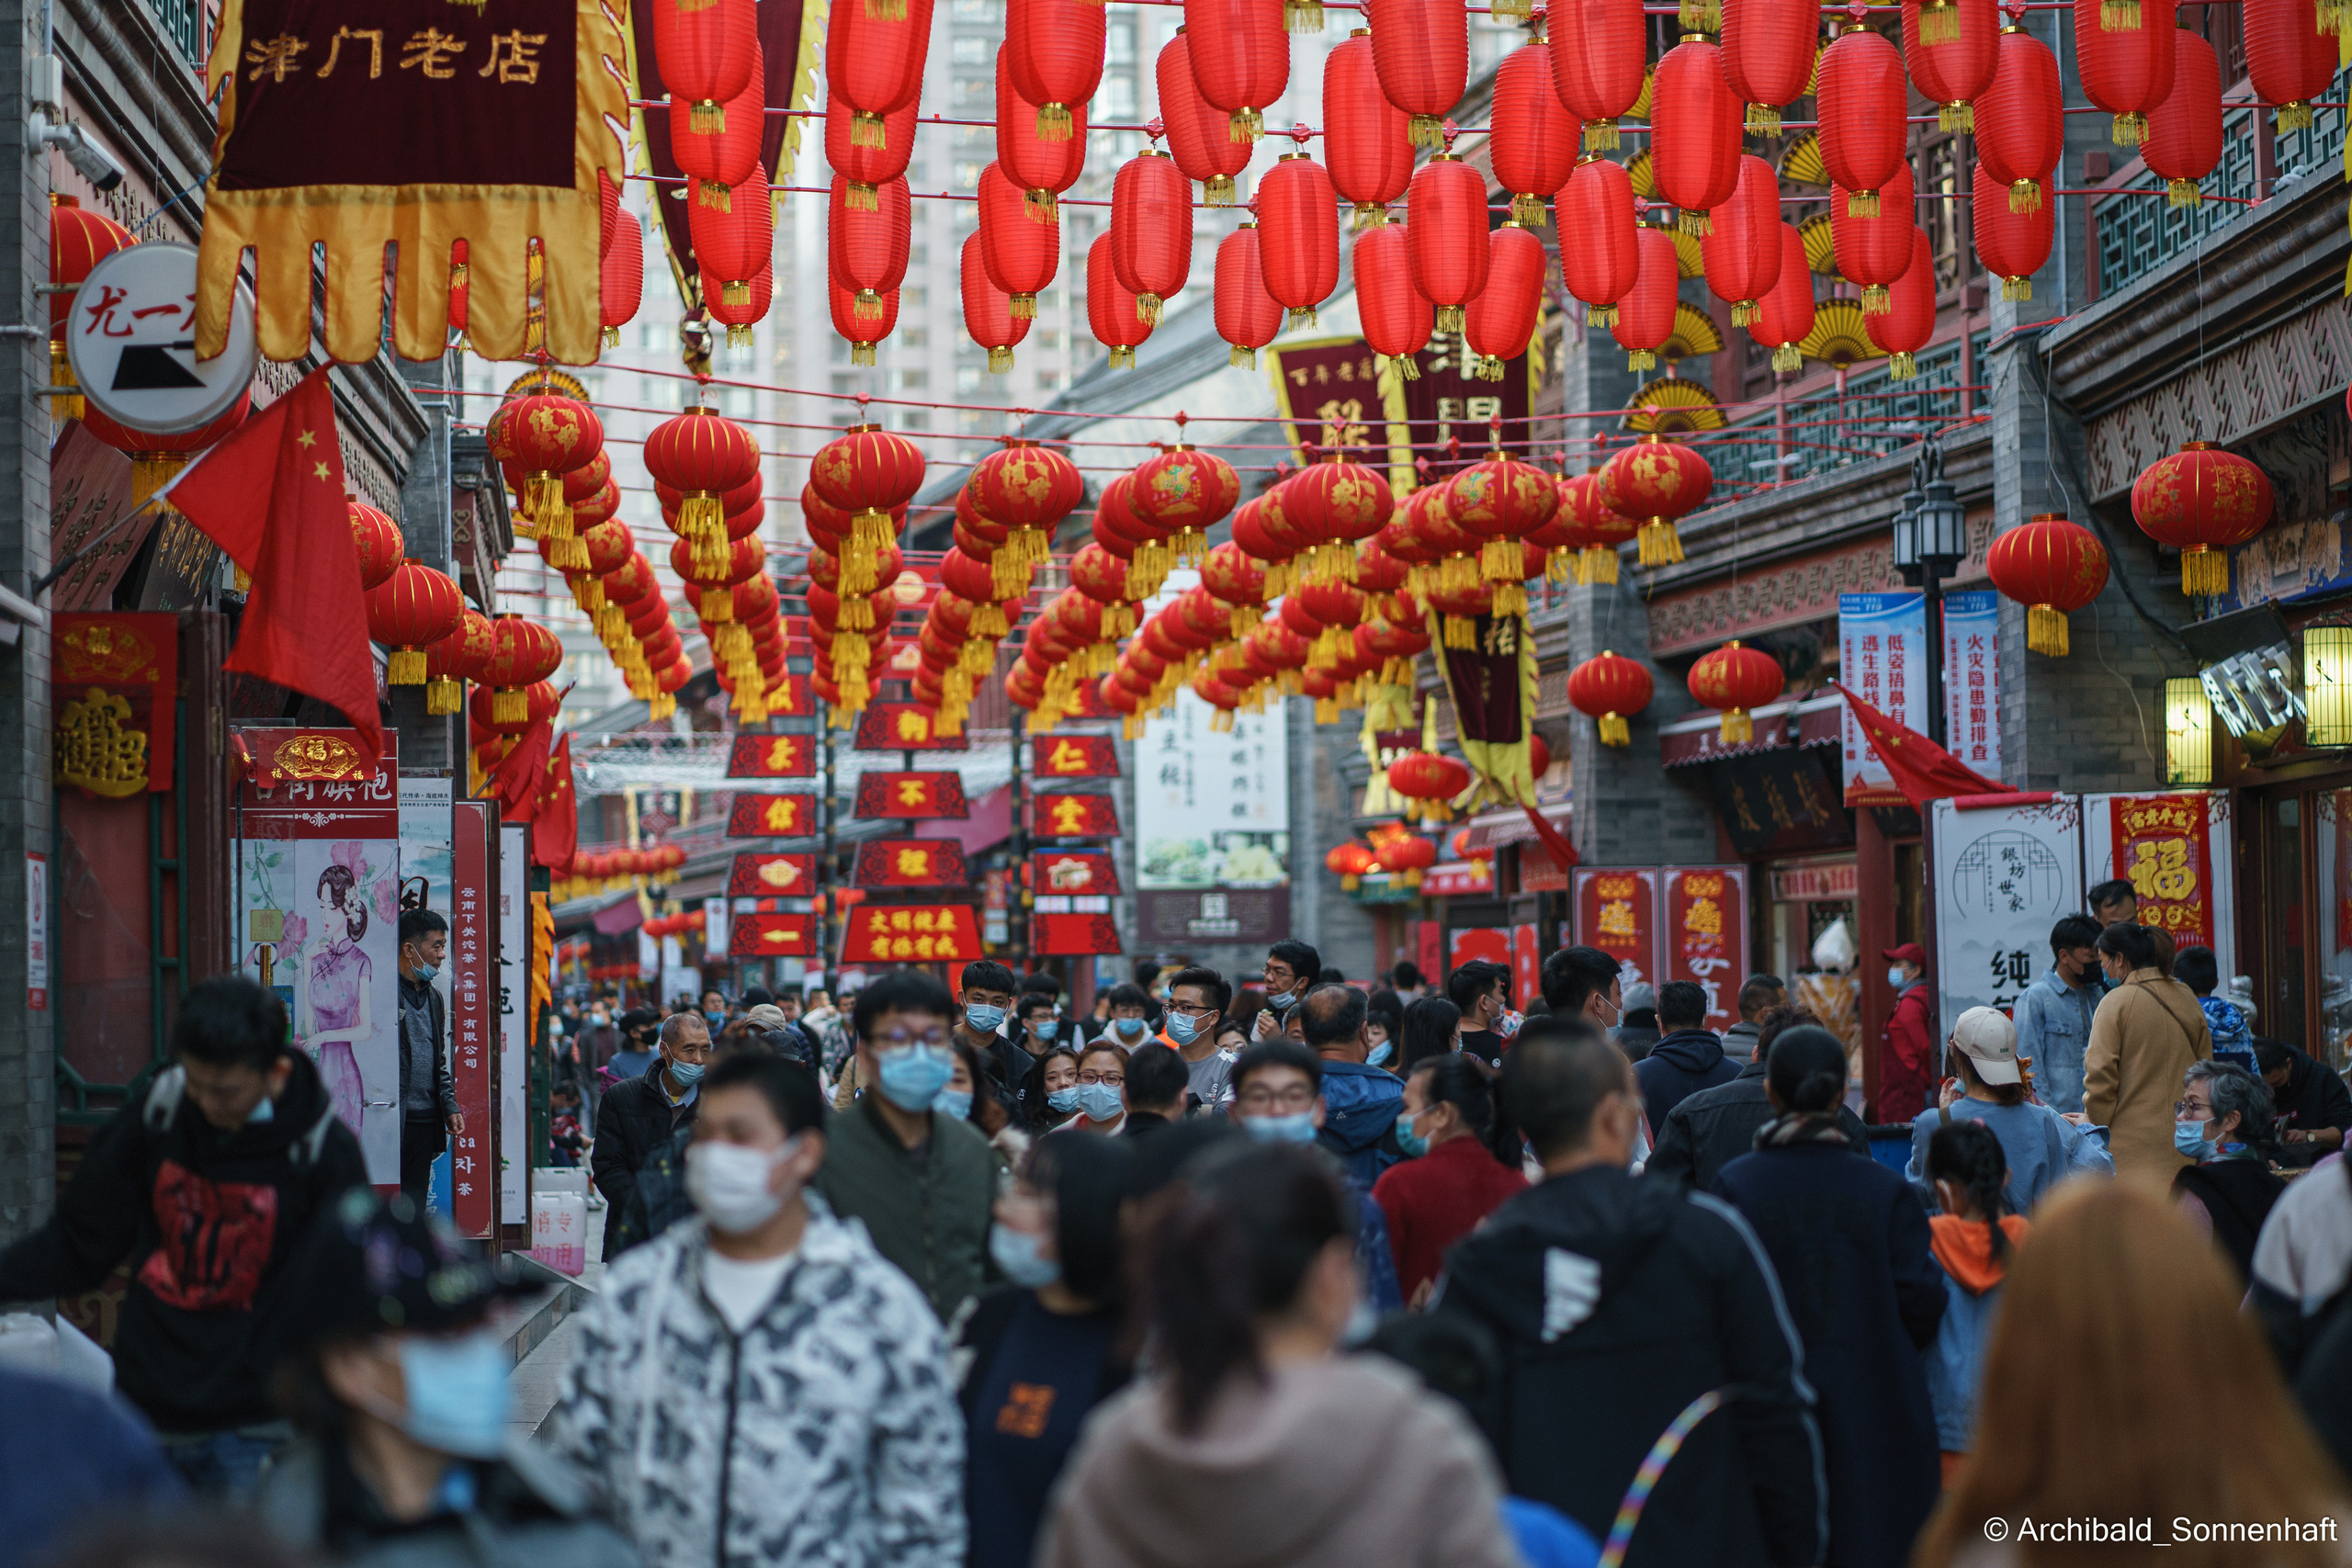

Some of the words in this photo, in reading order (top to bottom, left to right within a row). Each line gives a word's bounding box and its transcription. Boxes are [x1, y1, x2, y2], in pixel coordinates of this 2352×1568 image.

[245, 25, 548, 85] 津门老店
[85, 285, 196, 337] 尤一
[1861, 635, 1881, 762] 逃生路线悉
[1968, 633, 1988, 761] 火灾隐患勤排查
[307, 739, 329, 761] 福
[2127, 837, 2197, 901] 福
[459, 1136, 476, 1148] ea
[458, 1182, 473, 1196] 茶
